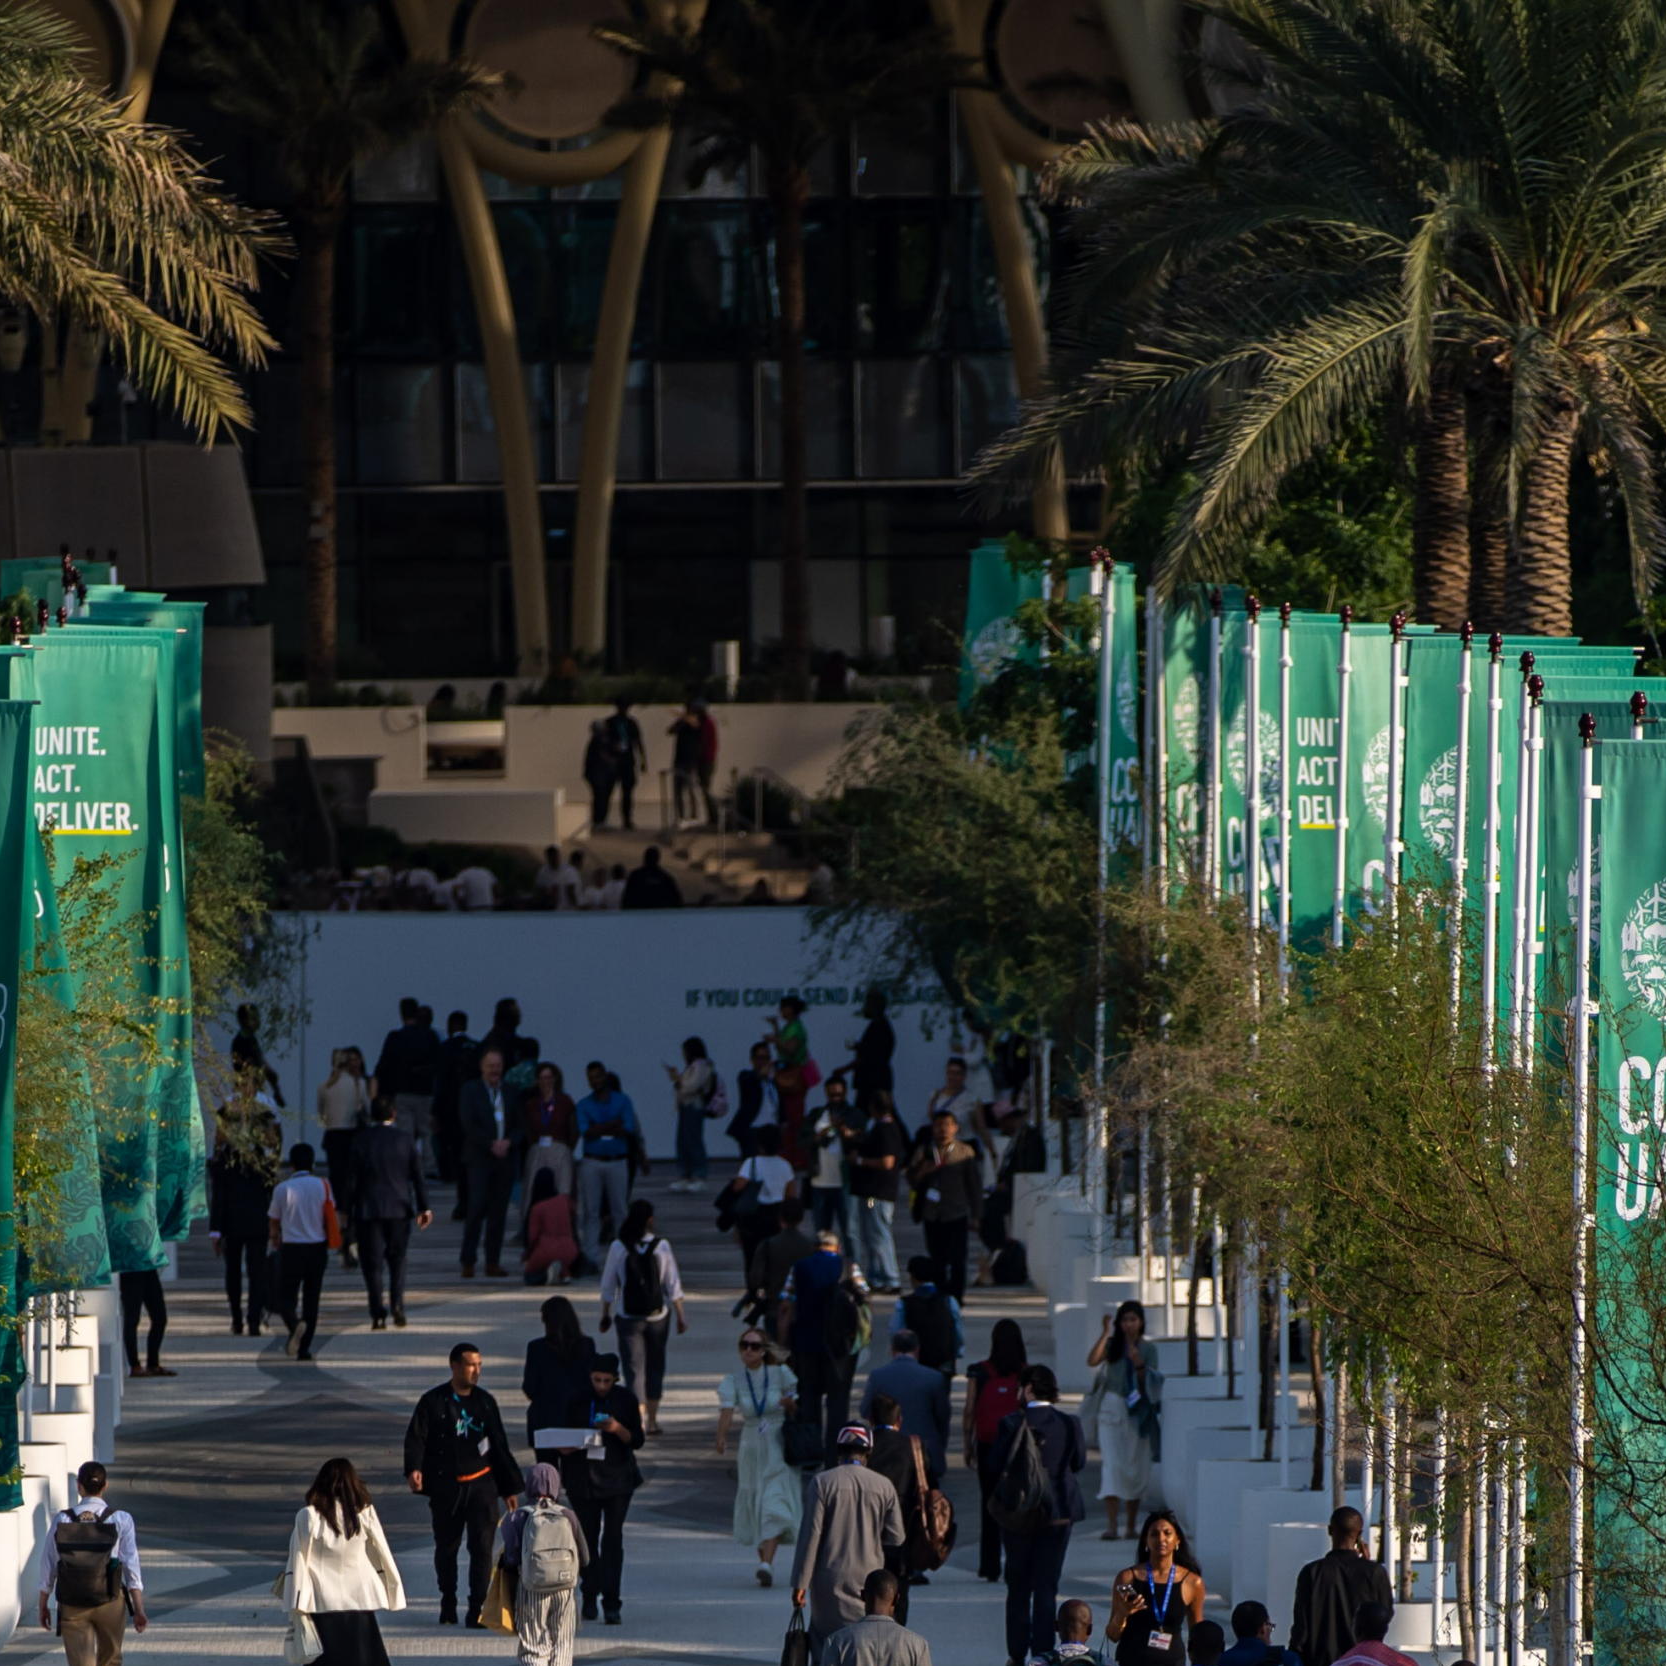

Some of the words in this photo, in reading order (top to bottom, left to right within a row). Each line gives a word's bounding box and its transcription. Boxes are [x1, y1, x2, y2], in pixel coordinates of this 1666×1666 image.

[34, 726, 107, 756] UNITE.
[34, 764, 81, 793] ACT.
[34, 802, 139, 831] DELIVER.
